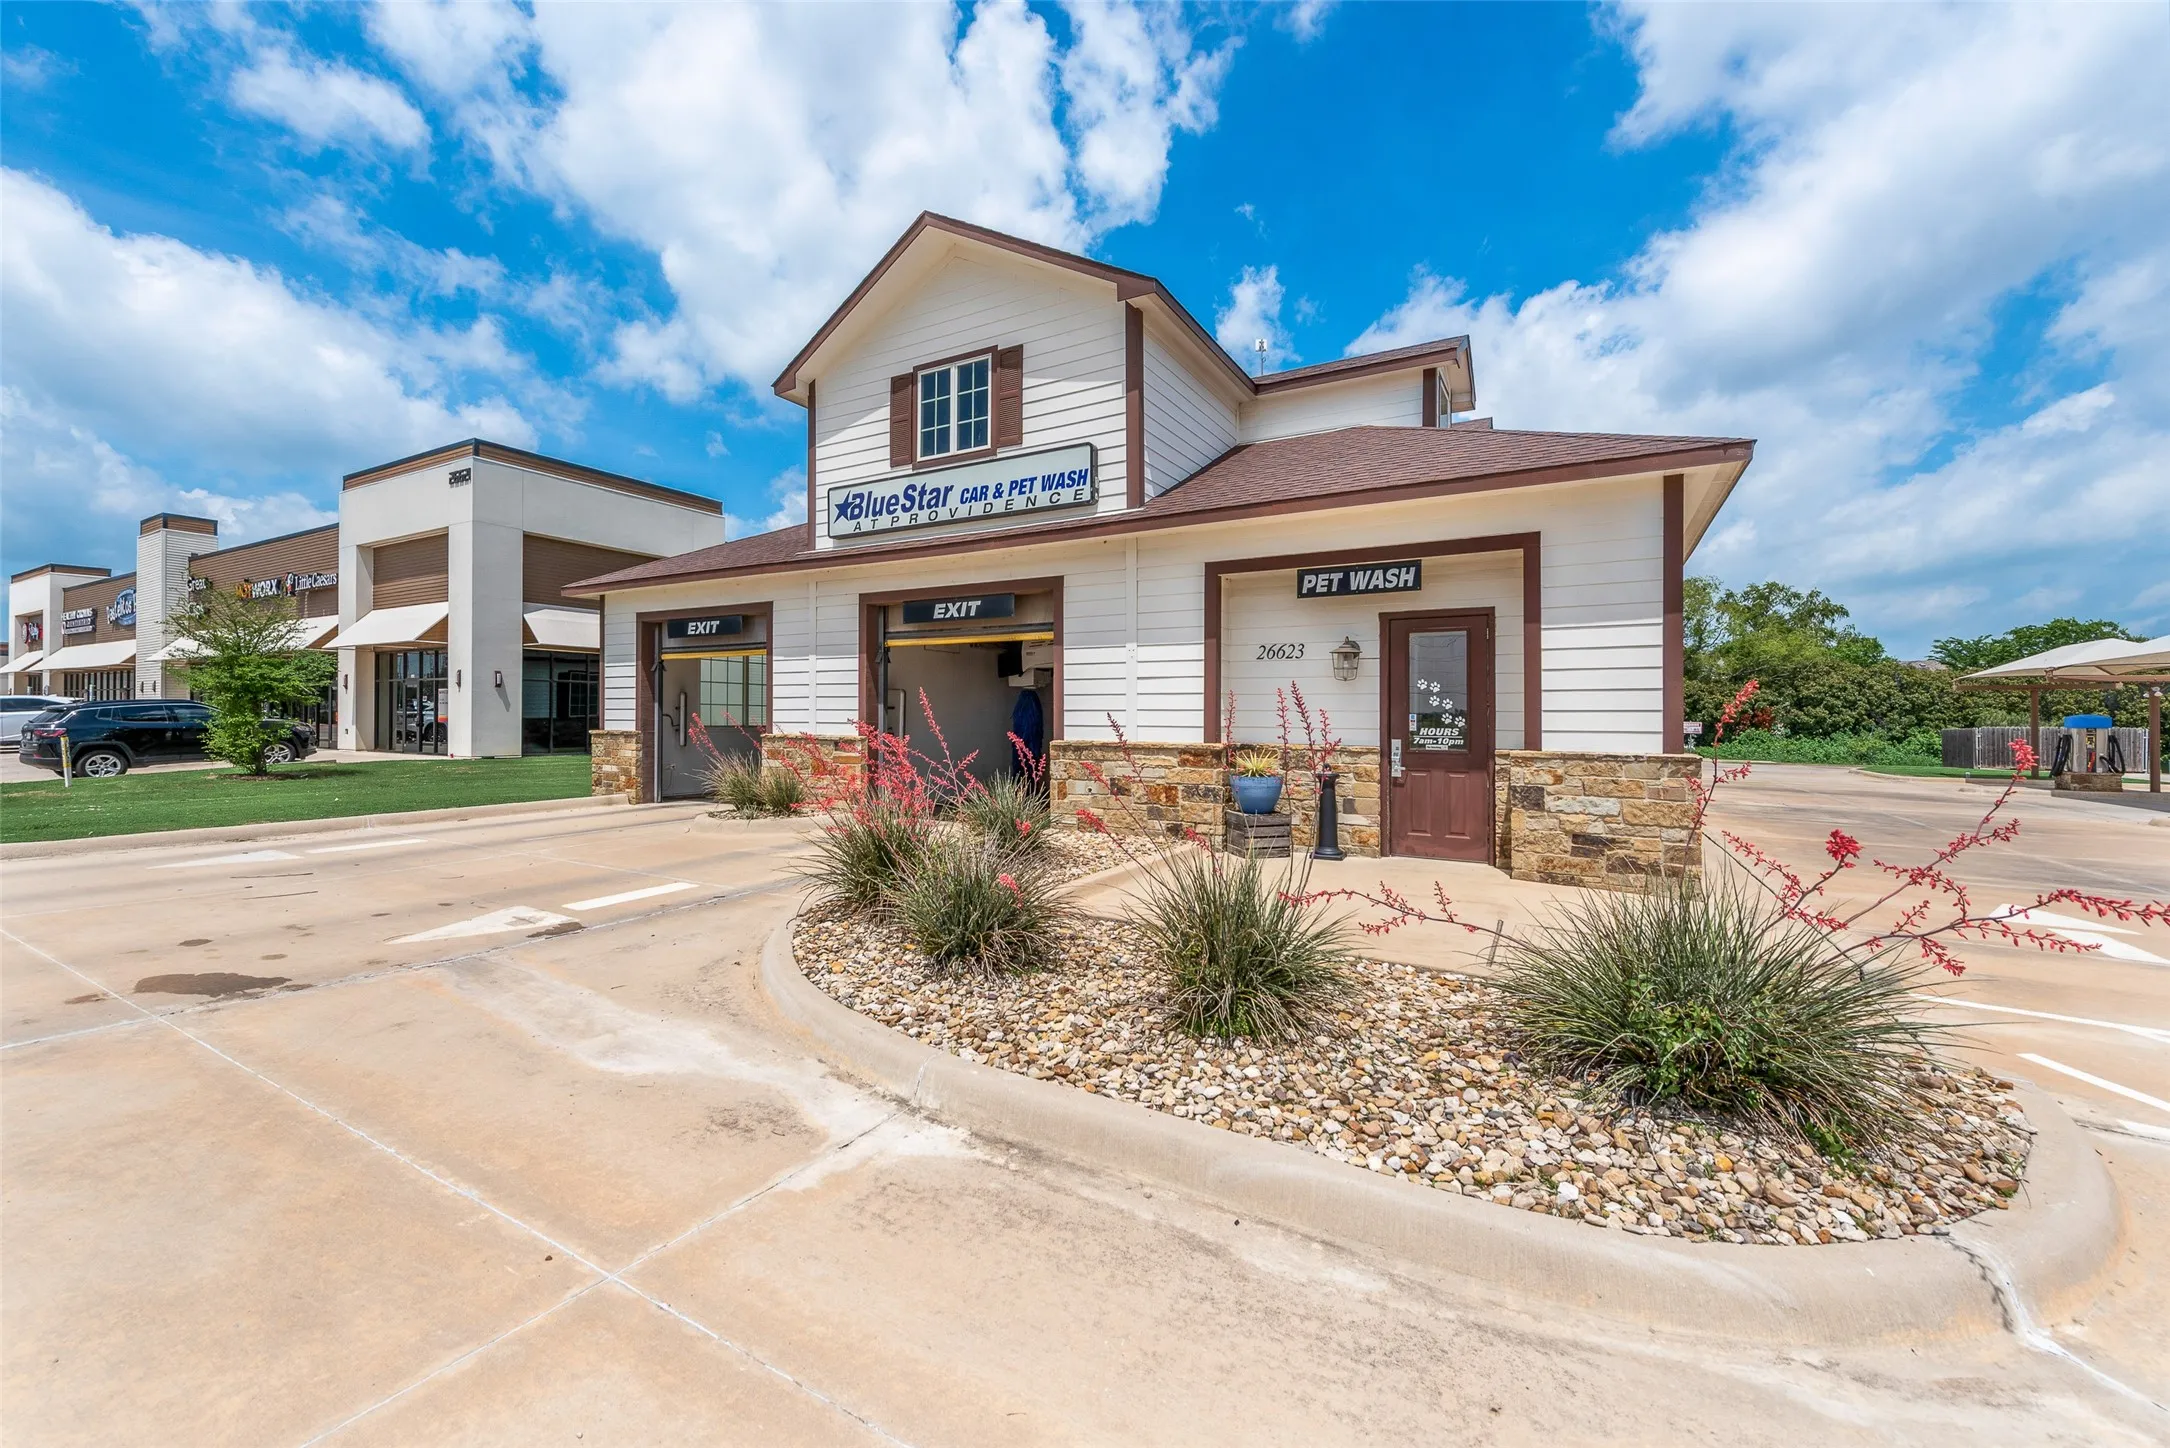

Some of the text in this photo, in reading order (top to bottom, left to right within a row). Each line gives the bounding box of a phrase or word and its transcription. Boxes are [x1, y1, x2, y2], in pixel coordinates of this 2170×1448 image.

[848, 468, 1089, 521] BlueStar CAR & PET WASH
[294, 572, 338, 591] Little Caesars
[1302, 566, 1416, 594] PET WASH
[933, 600, 981, 619] EXIT
[687, 620, 720, 635] EXIT
[1256, 643, 1305, 660] 26623
[1419, 727, 1460, 736] HOURS
[1413, 737, 1464, 746] 7am-10pm
